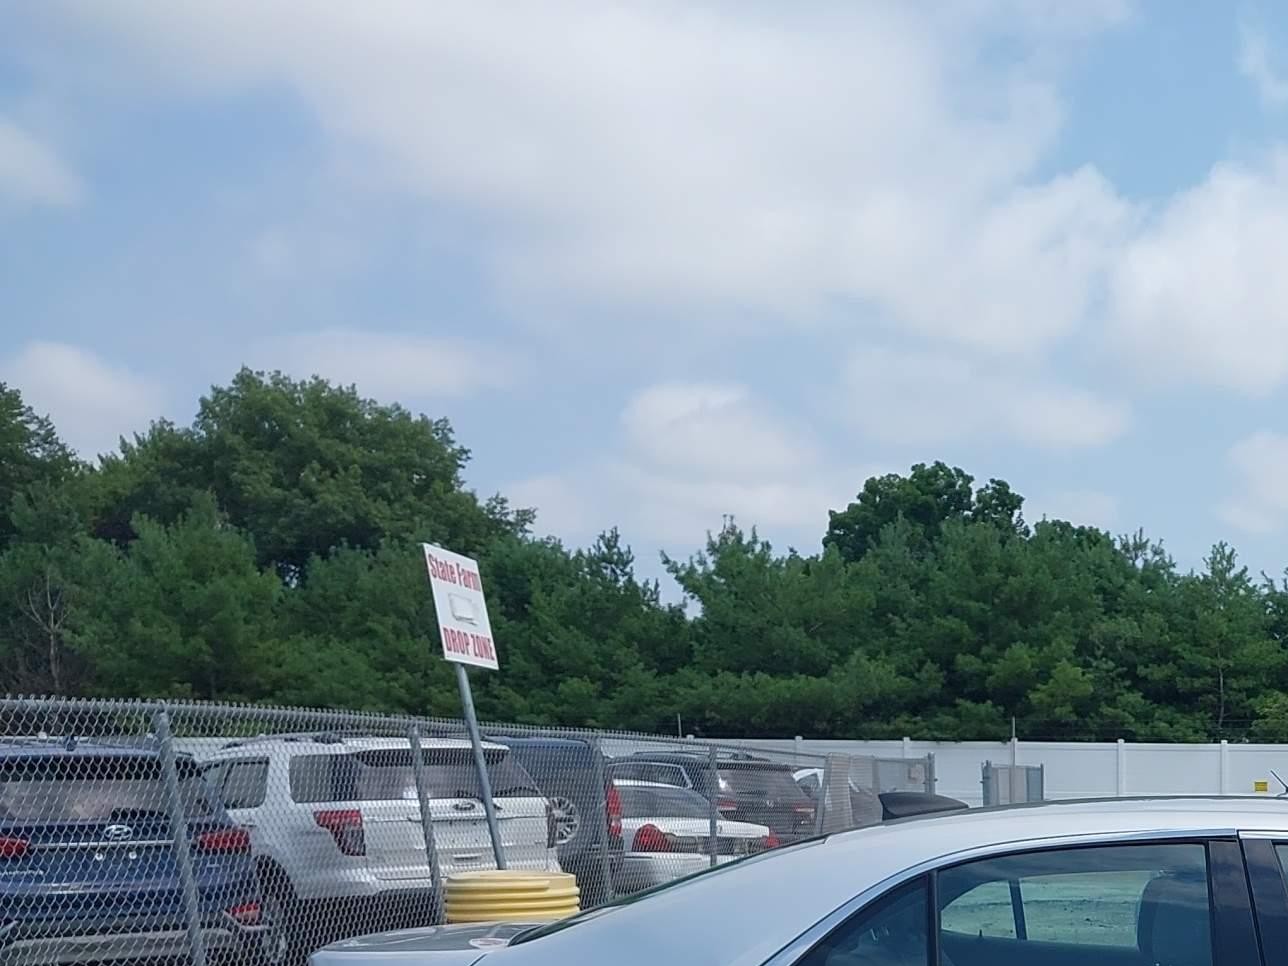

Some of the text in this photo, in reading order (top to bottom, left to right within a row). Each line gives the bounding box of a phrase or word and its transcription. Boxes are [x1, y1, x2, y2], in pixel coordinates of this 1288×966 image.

[428, 553, 457, 584] State
[443, 627, 495, 661] DROP ZONE
